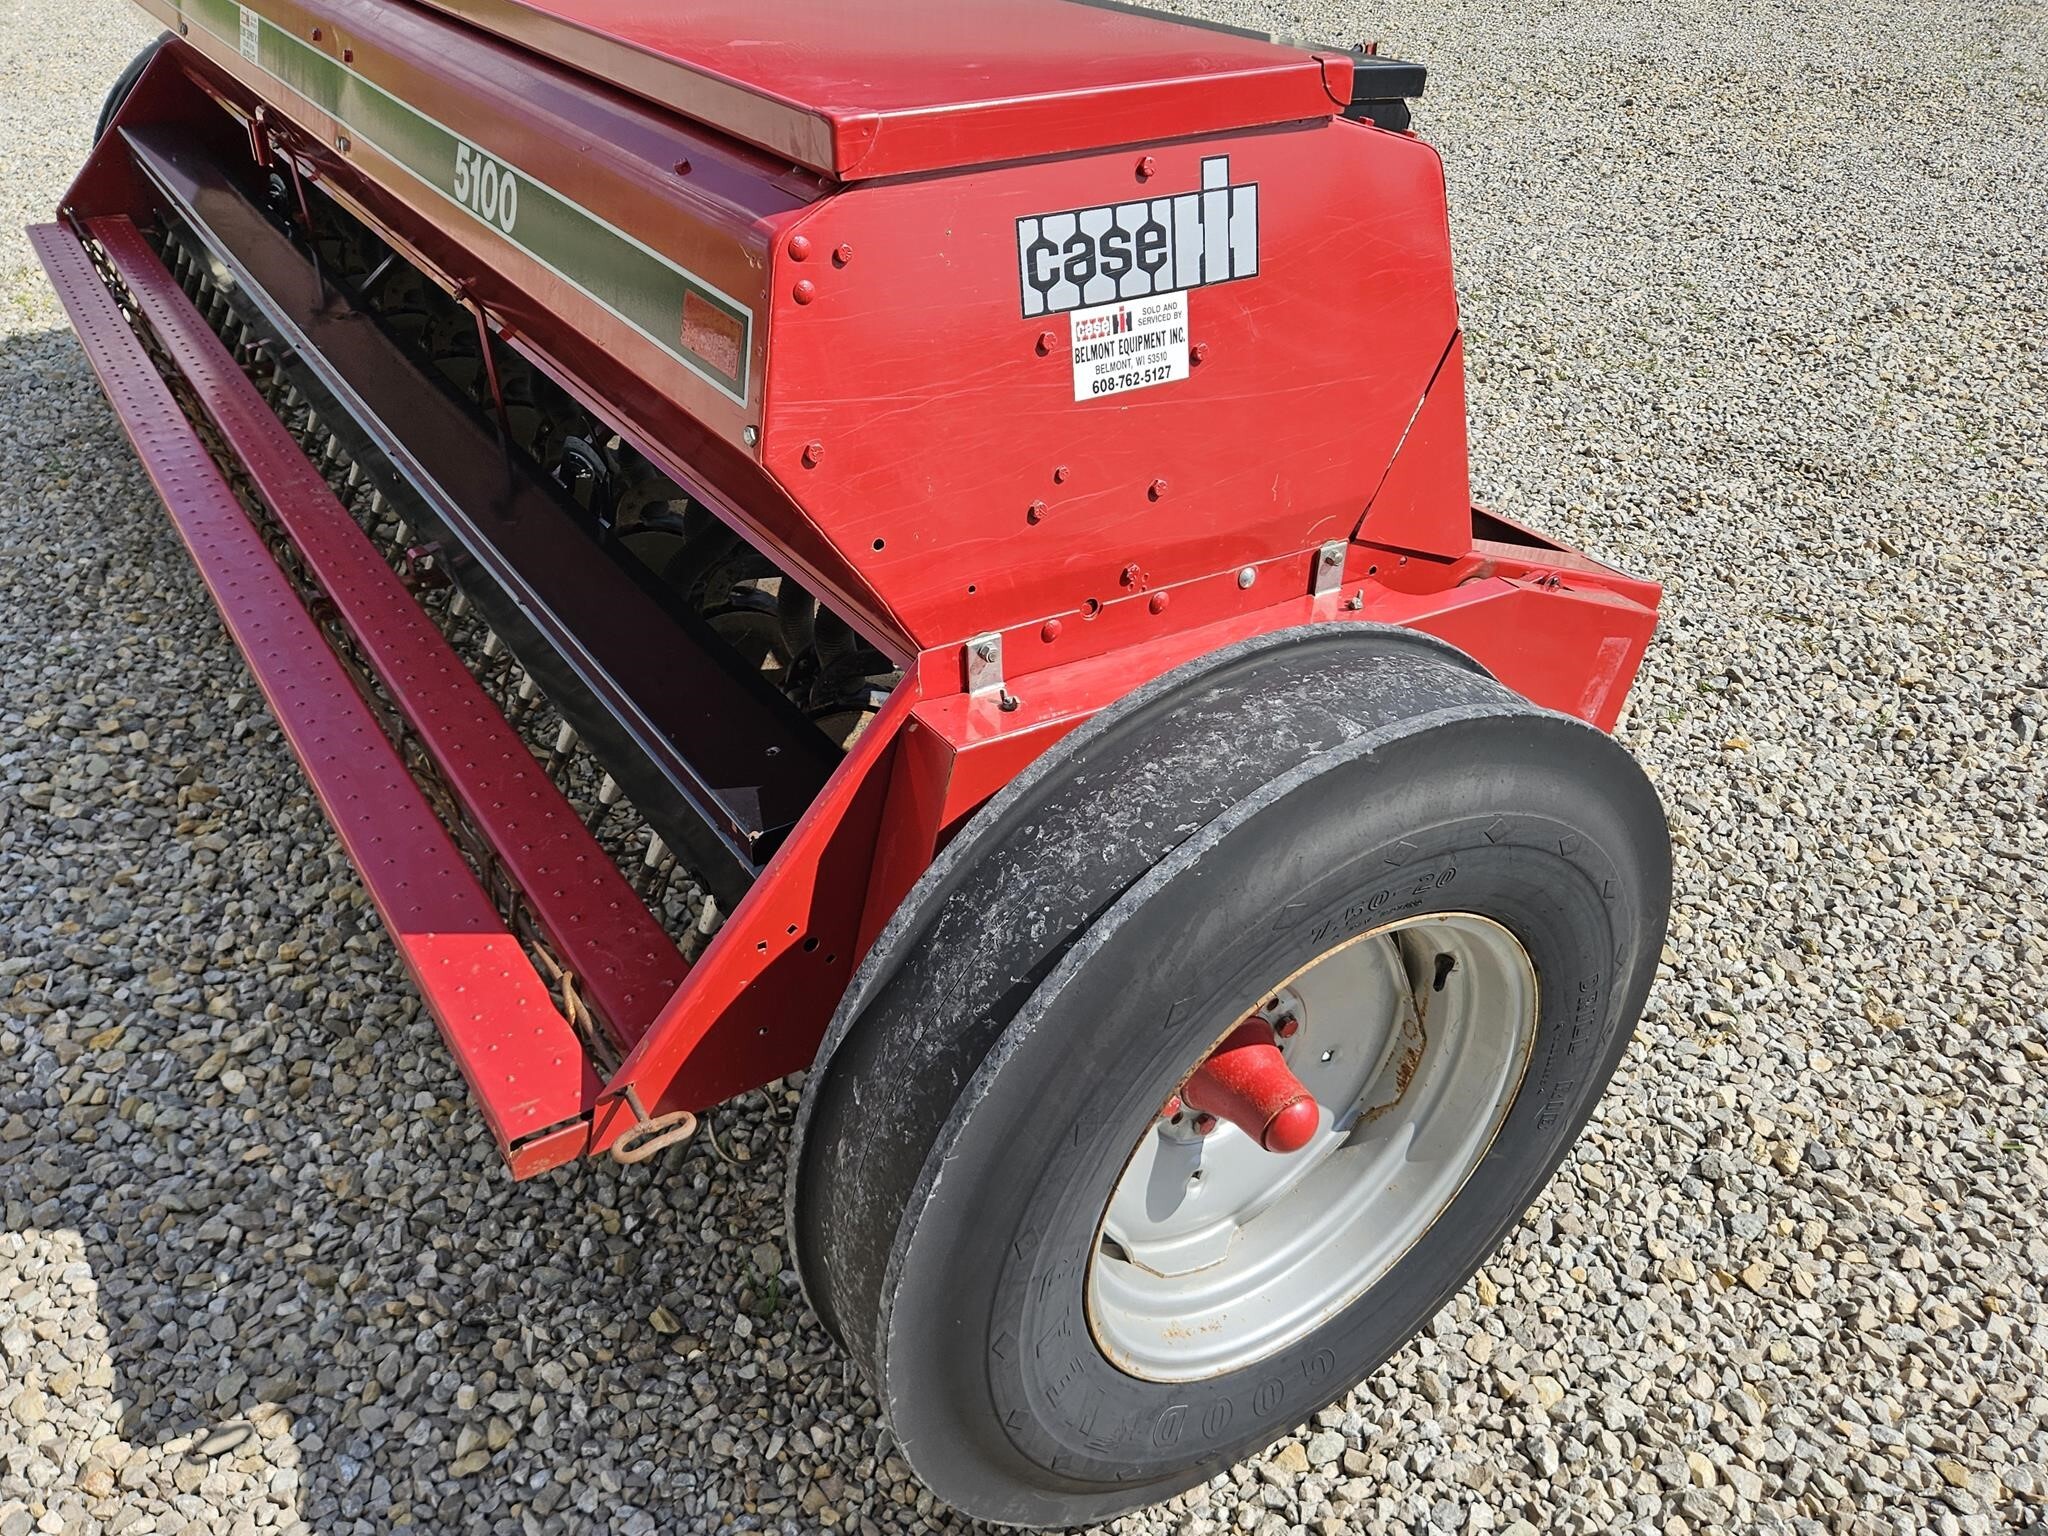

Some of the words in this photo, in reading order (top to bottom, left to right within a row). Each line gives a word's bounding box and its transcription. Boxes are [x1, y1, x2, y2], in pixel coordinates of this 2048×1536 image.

[454, 141, 517, 233] 5100
[1138, 313, 1171, 326] SERVICED
[1173, 311, 1182, 320] BY
[1142, 305, 1161, 315] SOLD
[1163, 302, 1178, 312] AND
[1075, 341, 1115, 364] BELMONT
[1118, 330, 1167, 355] EQUIPMENT
[1170, 327, 1186, 345] INC.
[1095, 359, 1134, 375] BELMONT,
[1136, 356, 1146, 366] WI
[1147, 352, 1168, 365] 53510
[1092, 365, 1172, 394] 608-762-5127
